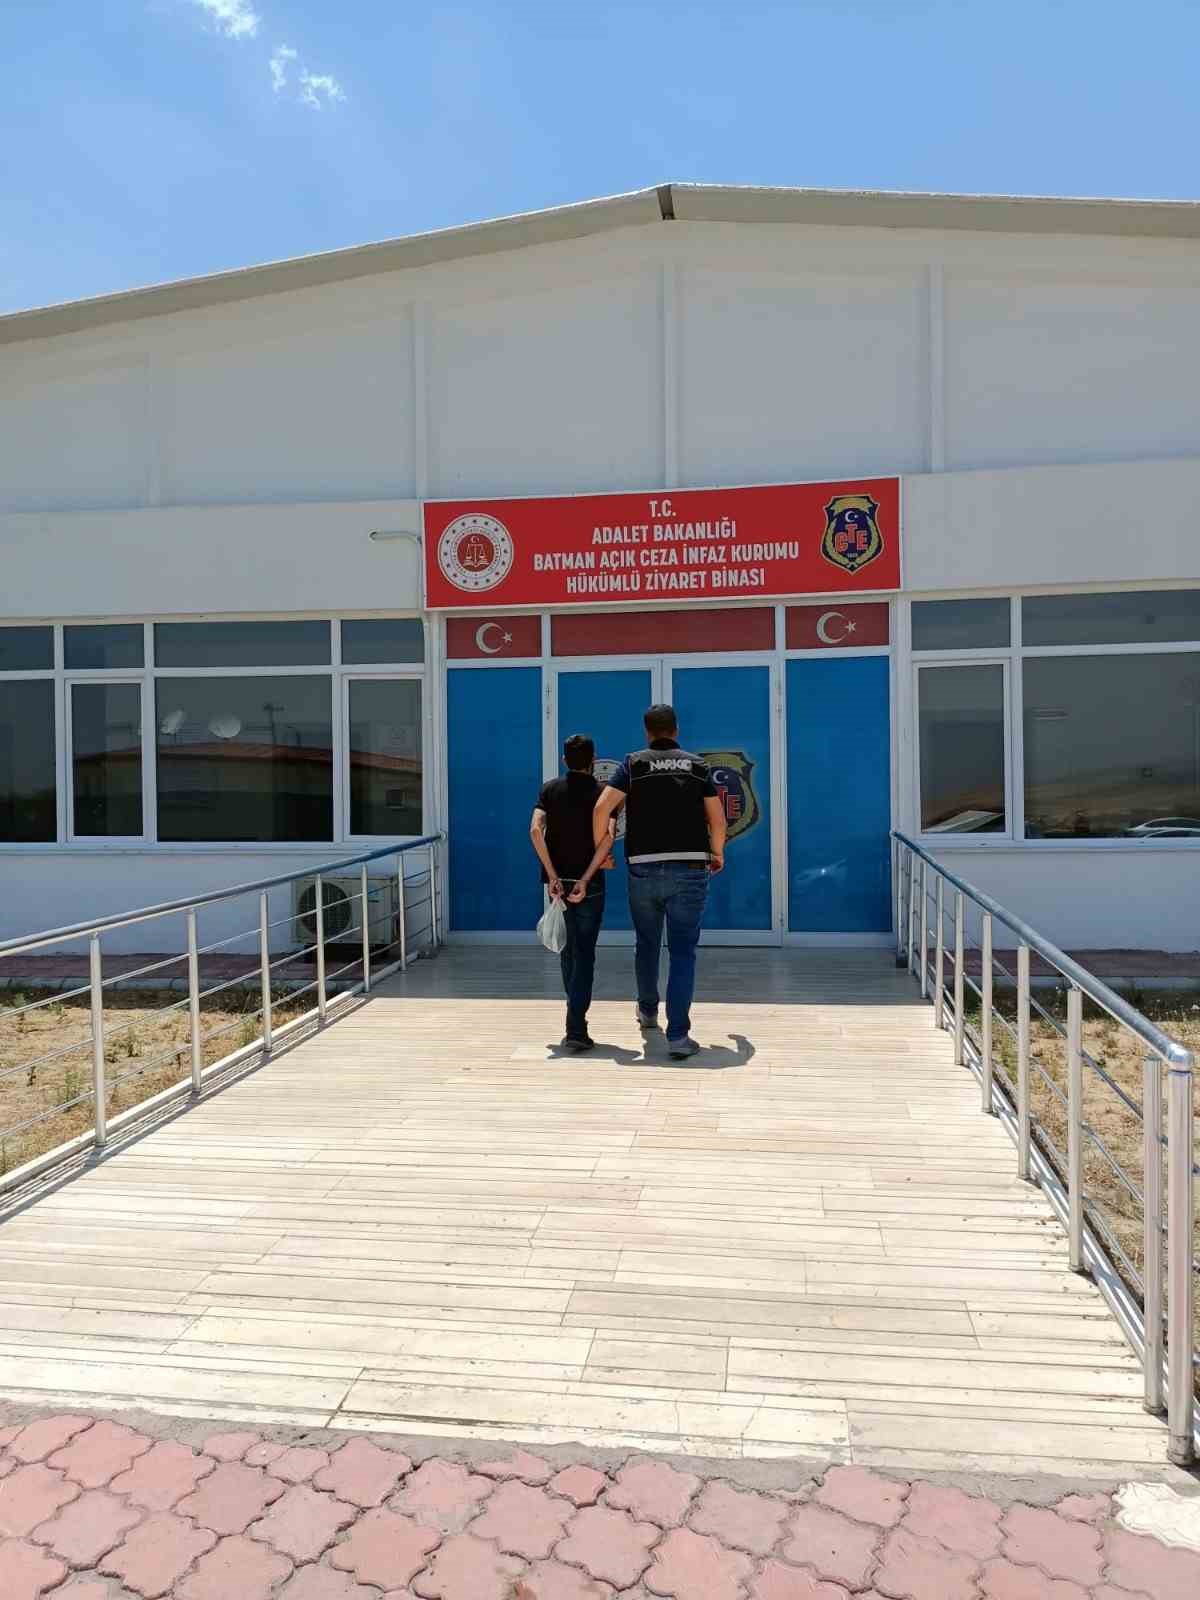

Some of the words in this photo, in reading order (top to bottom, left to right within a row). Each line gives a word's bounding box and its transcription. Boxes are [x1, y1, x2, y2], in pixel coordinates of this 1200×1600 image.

[649, 499, 677, 518] T.C.
[591, 525, 649, 545] ADALET
[653, 516, 737, 543] BAKANLIĞI
[533, 550, 595, 571] BATMAN
[599, 549, 636, 573] AÇIK
[639, 547, 679, 567] CEZA
[682, 543, 727, 566] İNFAZ
[731, 541, 799, 563] KURUMU
[566, 570, 641, 594] HÜKÜMLÜ
[644, 567, 707, 591] ZİYARET
[711, 565, 765, 588] BİNASI
